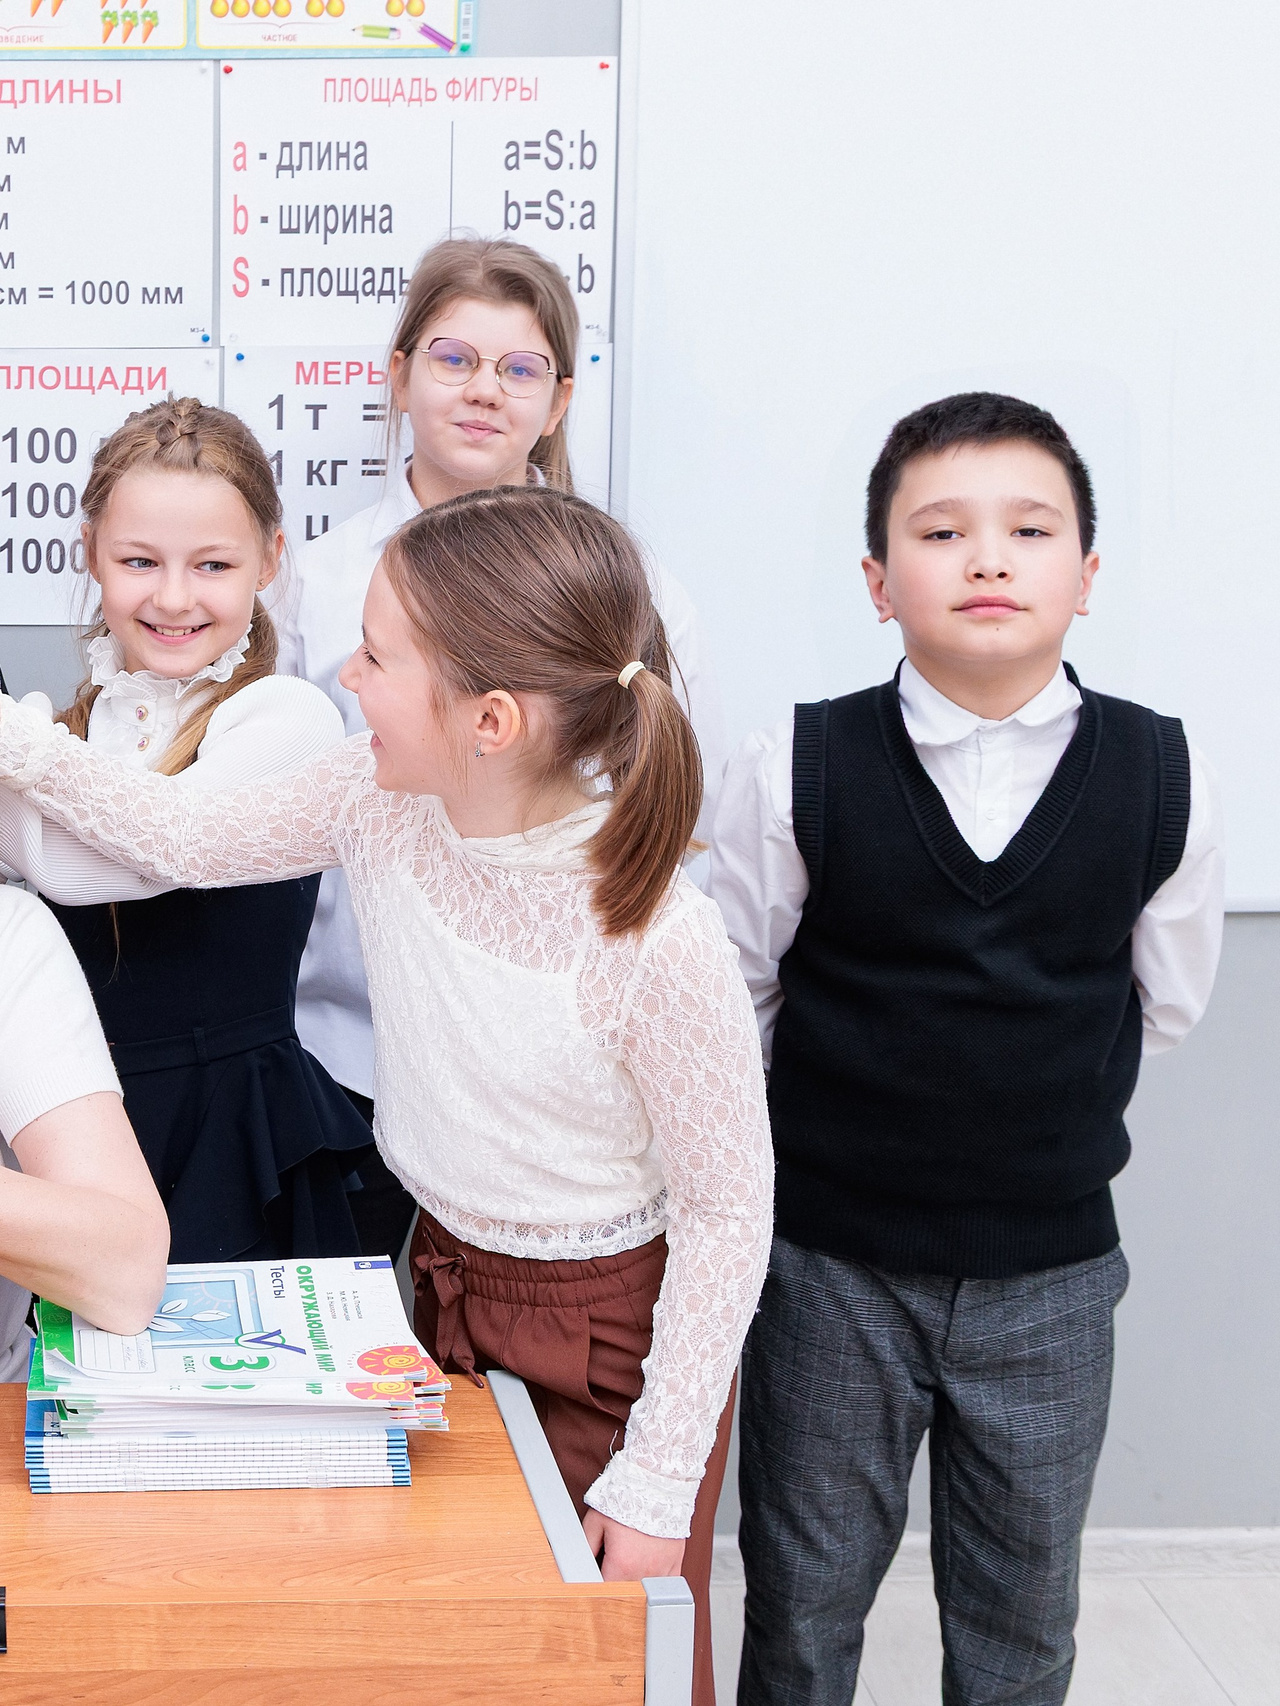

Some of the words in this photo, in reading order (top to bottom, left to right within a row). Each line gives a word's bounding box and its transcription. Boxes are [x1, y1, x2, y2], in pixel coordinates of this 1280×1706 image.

[261, 33, 298, 42] ЧАСТНОЕ
[325, 78, 437, 107] ПЛОЩАДЬ
[446, 78, 537, 101] ФИГУРЫ
[7, 137, 25, 154] м
[276, 141, 367, 178] длина
[234, 195, 248, 235] b
[280, 204, 392, 244] ширина
[66, 281, 129, 304] 1000
[142, 287, 182, 304] мм
[233, 257, 249, 297] S
[269, 394, 283, 430] 1
[305, 405, 327, 430] т
[2, 427, 76, 463] 100
[307, 460, 347, 485] кг
[2, 482, 76, 518] 100
[270, 1265, 286, 1299] Тесты
[296, 1265, 333, 1350] ОКРУЖАЮЩИЙ
[315, 1353, 336, 1373] МИР
[183, 1355, 195, 1372] класс
[209, 1356, 270, 1371] 3
